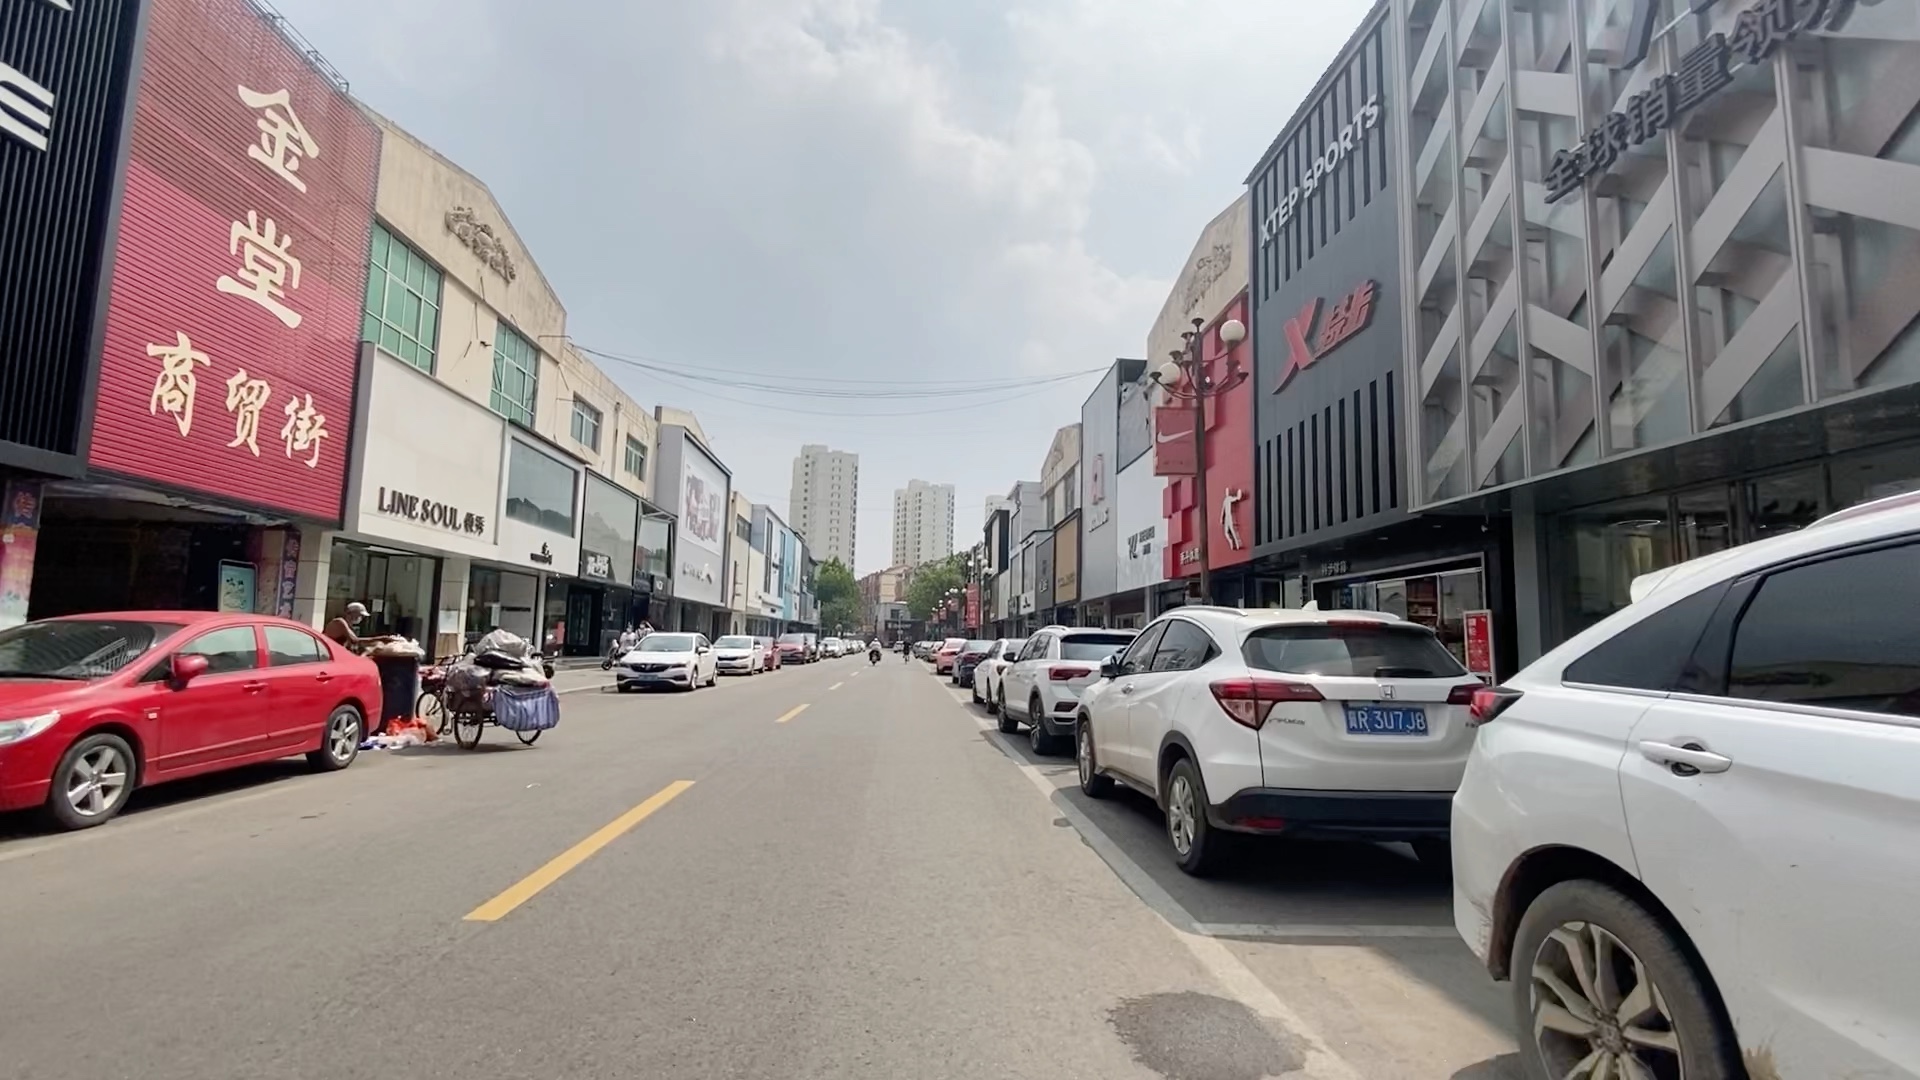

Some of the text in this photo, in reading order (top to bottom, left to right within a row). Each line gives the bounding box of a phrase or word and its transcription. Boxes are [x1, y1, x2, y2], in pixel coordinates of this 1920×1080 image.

[216, 84, 320, 329] 金堂
[1261, 93, 1379, 248] XTEP SPORTS
[146, 330, 329, 468] 商贸街
[378, 486, 419, 520] LINE
[420, 499, 462, 531] SOUL
